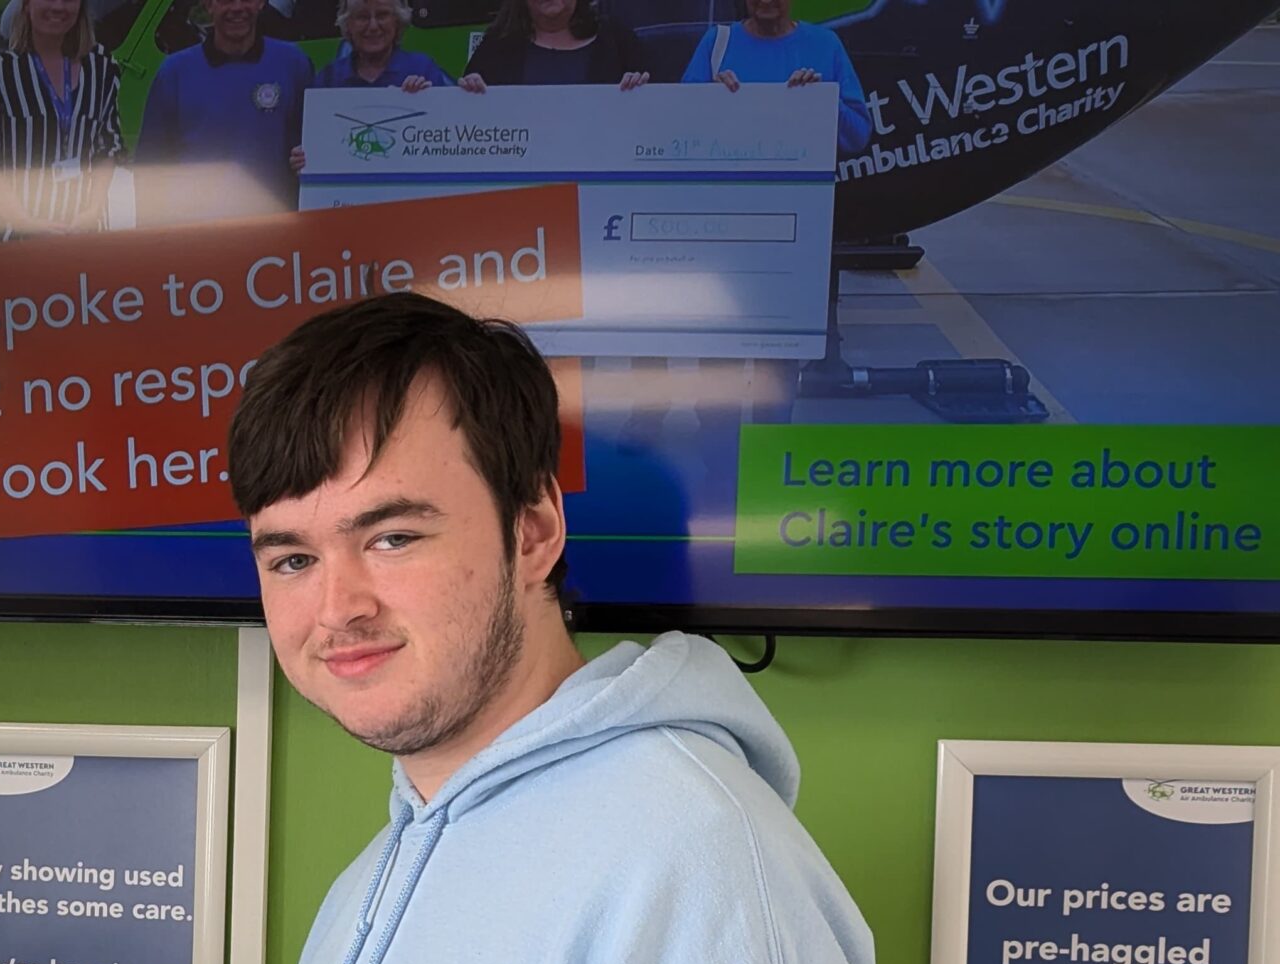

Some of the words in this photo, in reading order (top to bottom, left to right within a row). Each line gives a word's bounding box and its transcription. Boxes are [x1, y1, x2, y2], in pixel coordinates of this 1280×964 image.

[897, 34, 1129, 126] Western
[402, 125, 451, 144] Great
[455, 125, 529, 142] Western
[835, 122, 1009, 183] mbulance
[1017, 81, 1125, 136] Charity
[402, 145, 419, 156] Air
[422, 145, 487, 156] Ambulance
[489, 144, 527, 158] Charity
[635, 145, 665, 156] Date
[603, 214, 624, 241] £
[162, 277, 223, 318] to
[245, 251, 415, 305] Claire
[437, 227, 548, 291] and
[24, 373, 91, 415] no
[128, 437, 230, 491] her.
[783, 451, 911, 489] Learn
[929, 456, 1055, 489] more
[1071, 448, 1218, 491] about
[779, 509, 953, 549] Claire's
[970, 516, 1094, 558] story
[1111, 510, 1263, 552] online
[18, 762, 54, 770] WESTERN
[33, 770, 54, 778] Charity
[10, 863, 117, 891] showing
[124, 865, 185, 888] used
[57, 899, 124, 919] some
[132, 902, 194, 921] care.
[986, 879, 1052, 909] Our
[1063, 883, 1166, 916] prices
[1176, 891, 1233, 914] are
